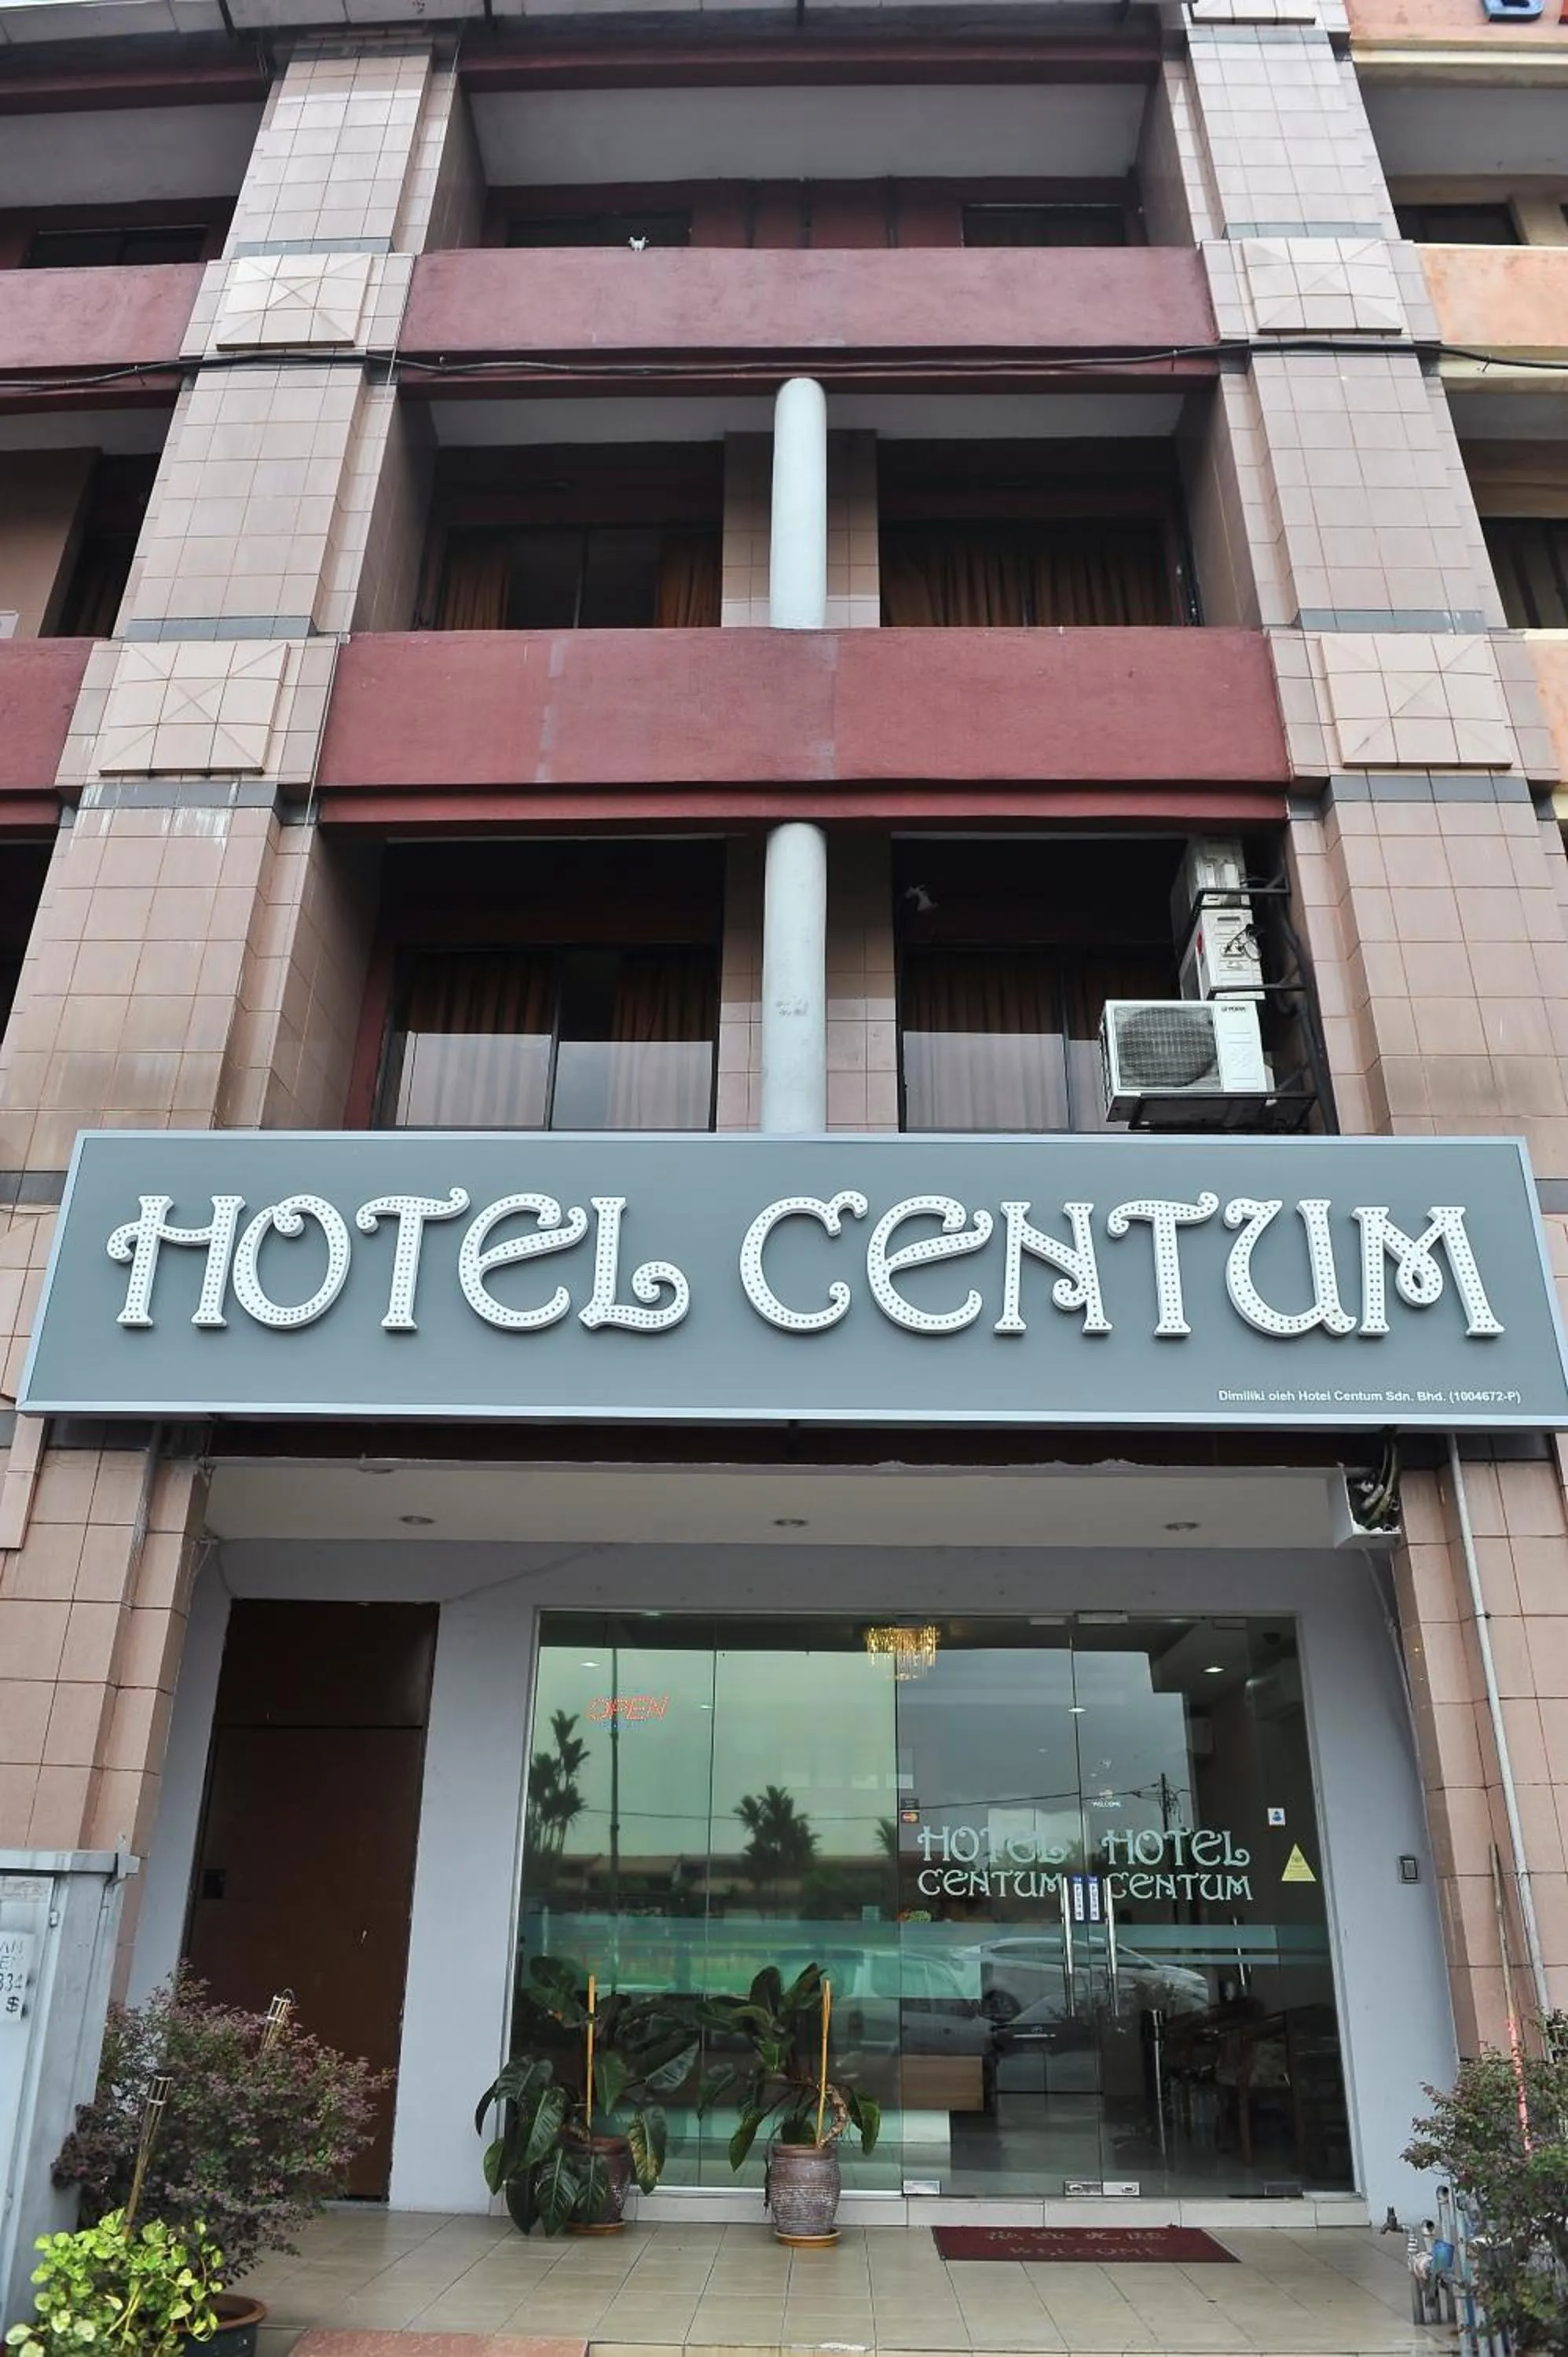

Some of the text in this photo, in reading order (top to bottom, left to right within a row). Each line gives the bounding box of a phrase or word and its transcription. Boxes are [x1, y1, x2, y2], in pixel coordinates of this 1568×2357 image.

[106, 1187, 1504, 1338] HOTEL CENTUM
[1218, 1390, 1522, 1404] Dimiliki oleh Hotel Centum Sdn. Bhd. (1004672-P)
[590, 1695, 669, 1721] OPEN
[1101, 1827, 1251, 1867] HOTEL
